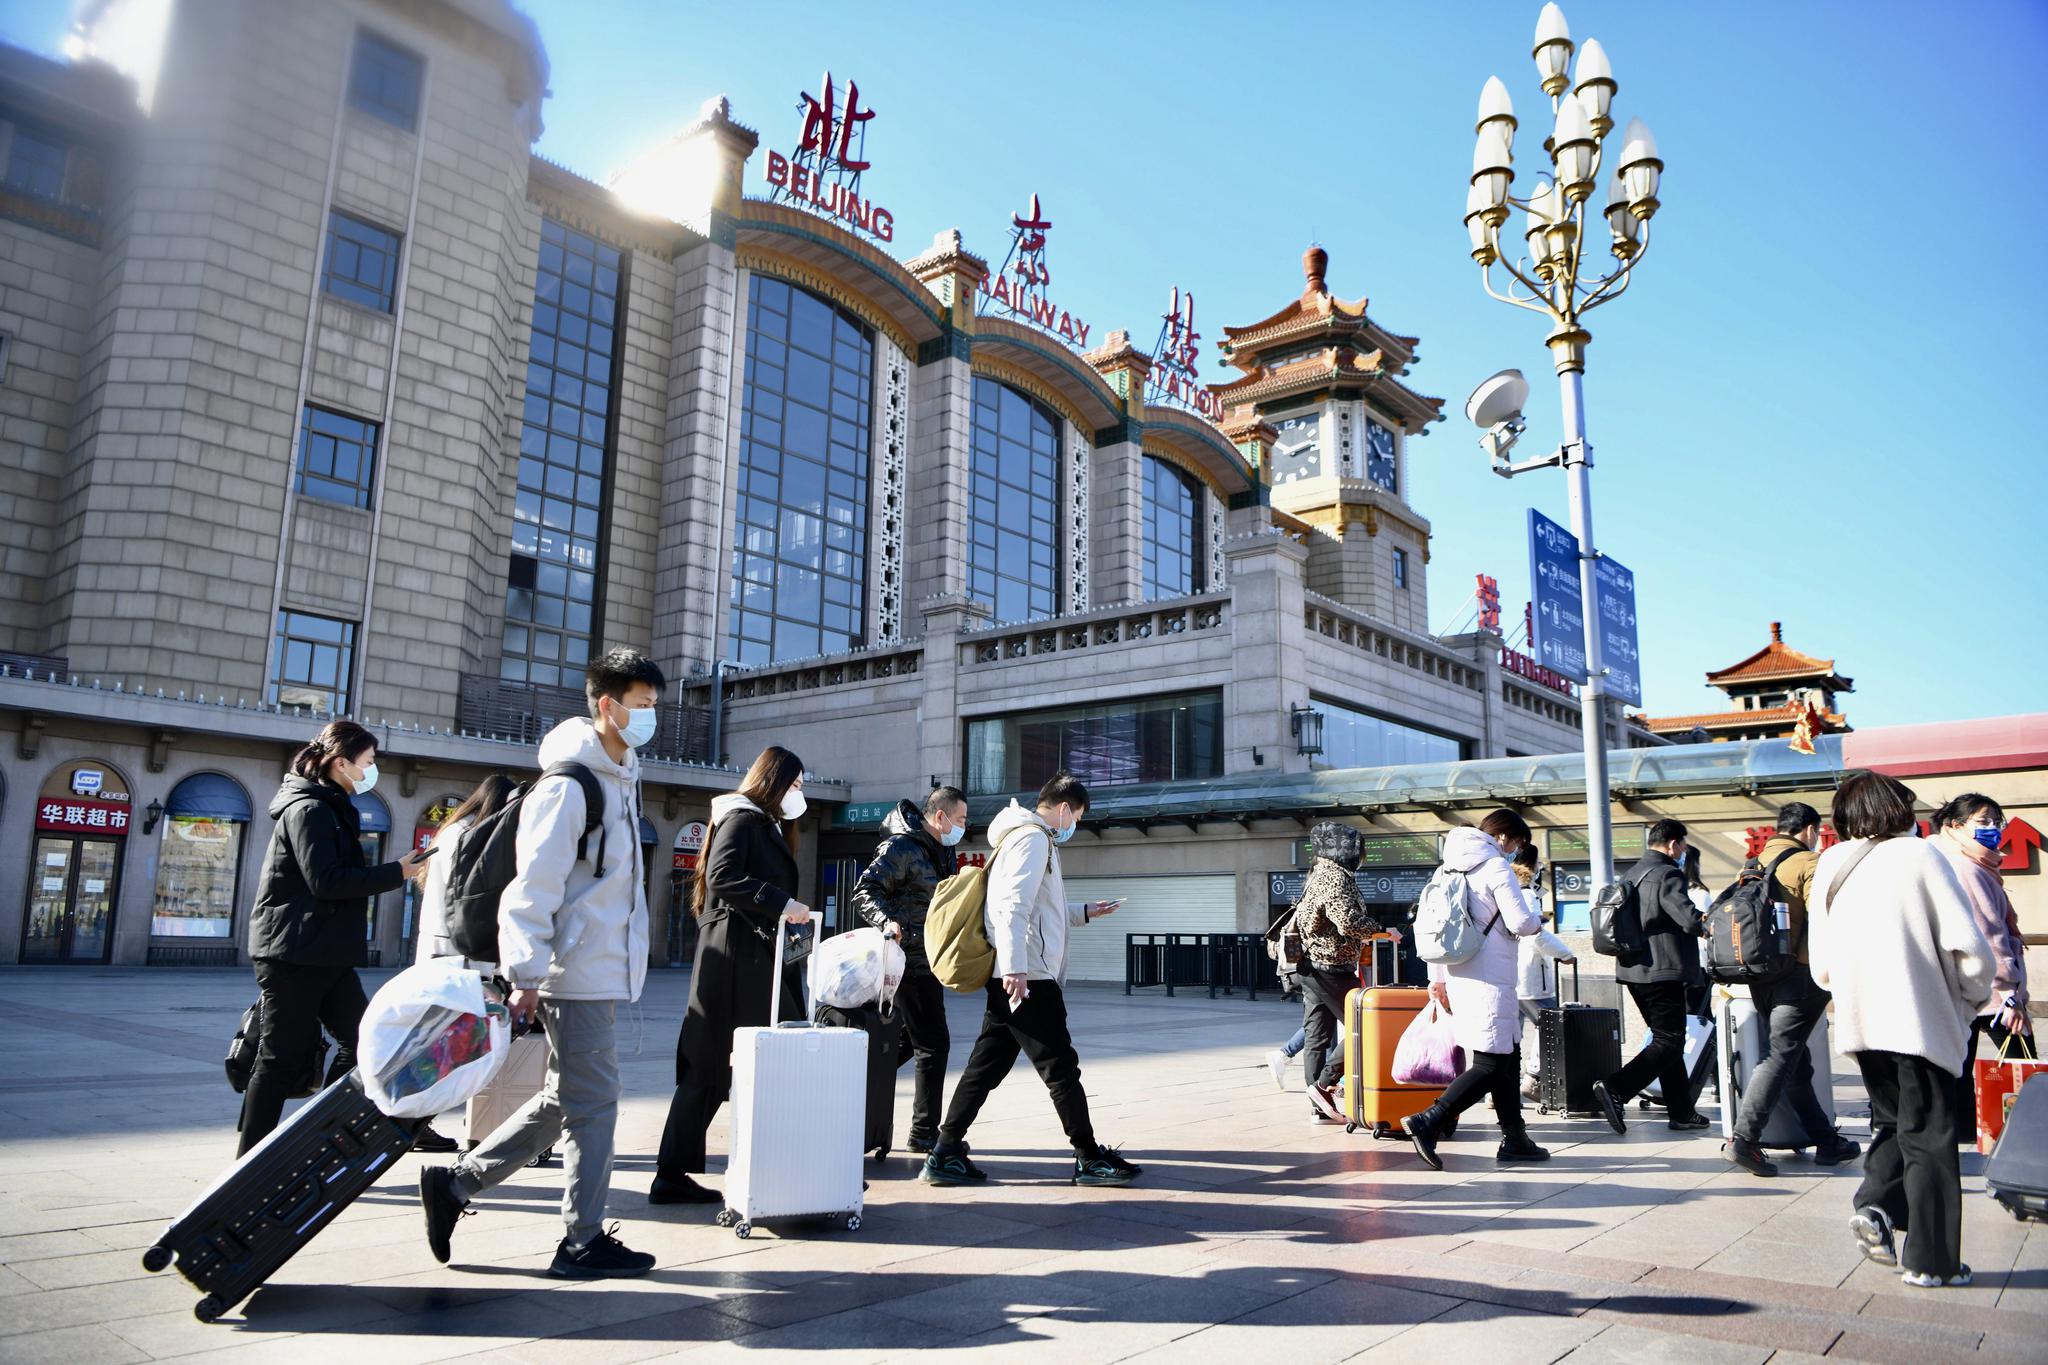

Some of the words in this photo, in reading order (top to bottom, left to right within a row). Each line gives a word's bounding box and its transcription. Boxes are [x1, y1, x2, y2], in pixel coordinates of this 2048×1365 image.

[799, 71, 876, 171] 北
[764, 147, 894, 243] BEIJING
[42, 804, 129, 828] 华联超市
